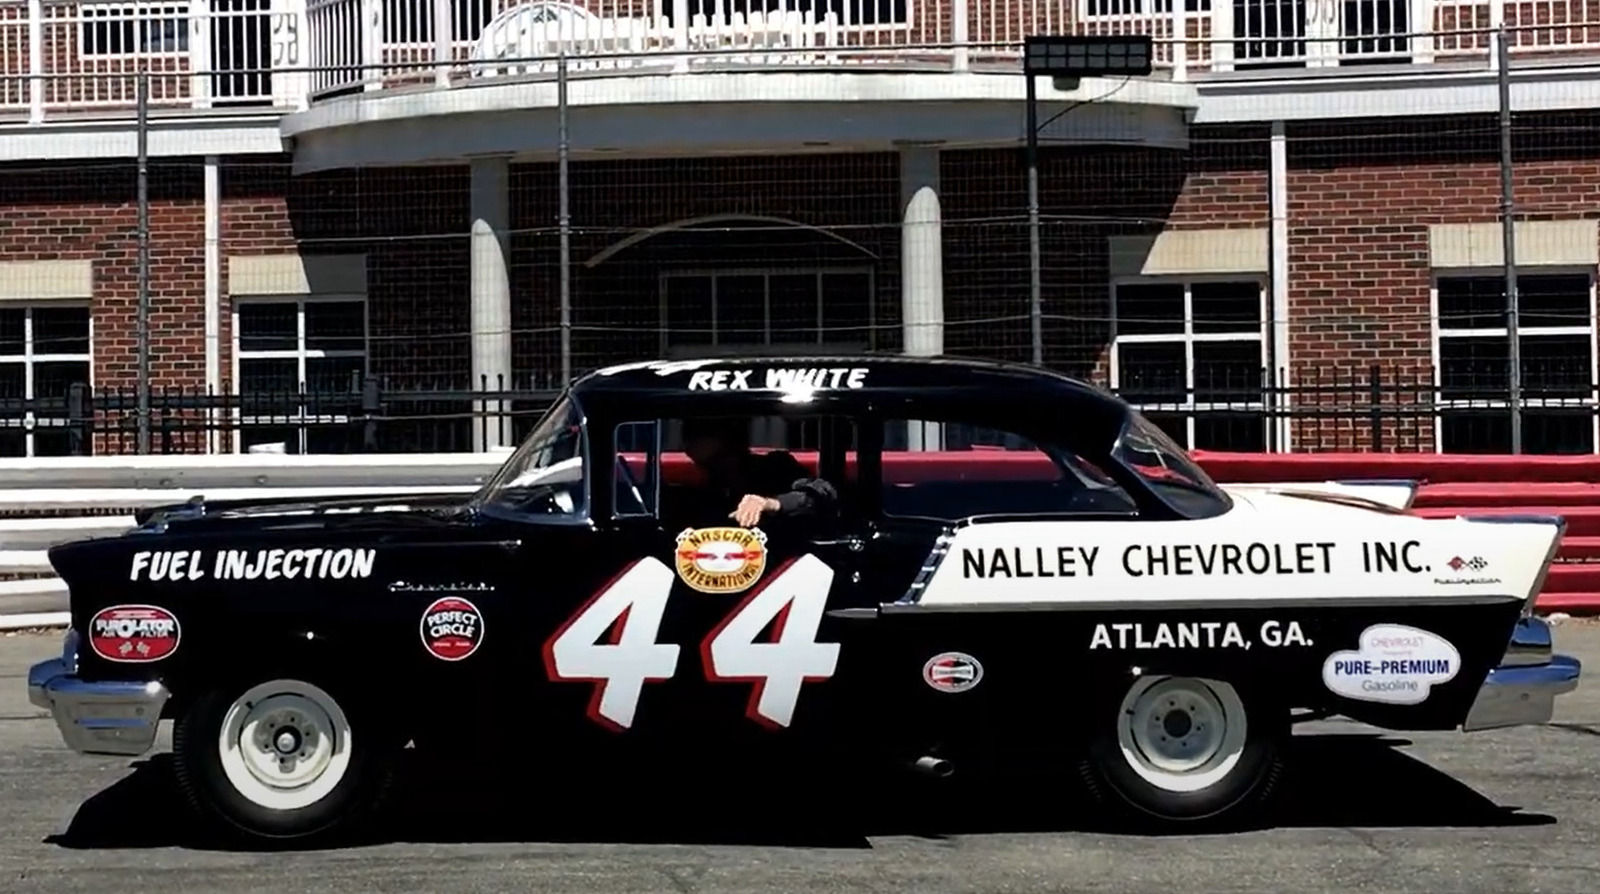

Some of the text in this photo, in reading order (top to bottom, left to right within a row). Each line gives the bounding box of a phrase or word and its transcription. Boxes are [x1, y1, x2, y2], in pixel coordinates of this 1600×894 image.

[687, 367, 870, 391] REX WHITE
[688, 529, 753, 548] NASCAR
[130, 547, 377, 582] FUEL INJECTION
[961, 540, 1432, 580] NALLEY CHEVROLET INC.
[682, 563, 760, 588] INTERNATIONAL
[427, 610, 478, 627] PERFECT
[430, 623, 476, 638] CIRCLE
[543, 552, 841, 732] 44
[1088, 620, 1315, 652] ATLANTA, GA.
[1335, 659, 1450, 675] PURE-PREMIUM
[1361, 680, 1419, 692] Gasoline
